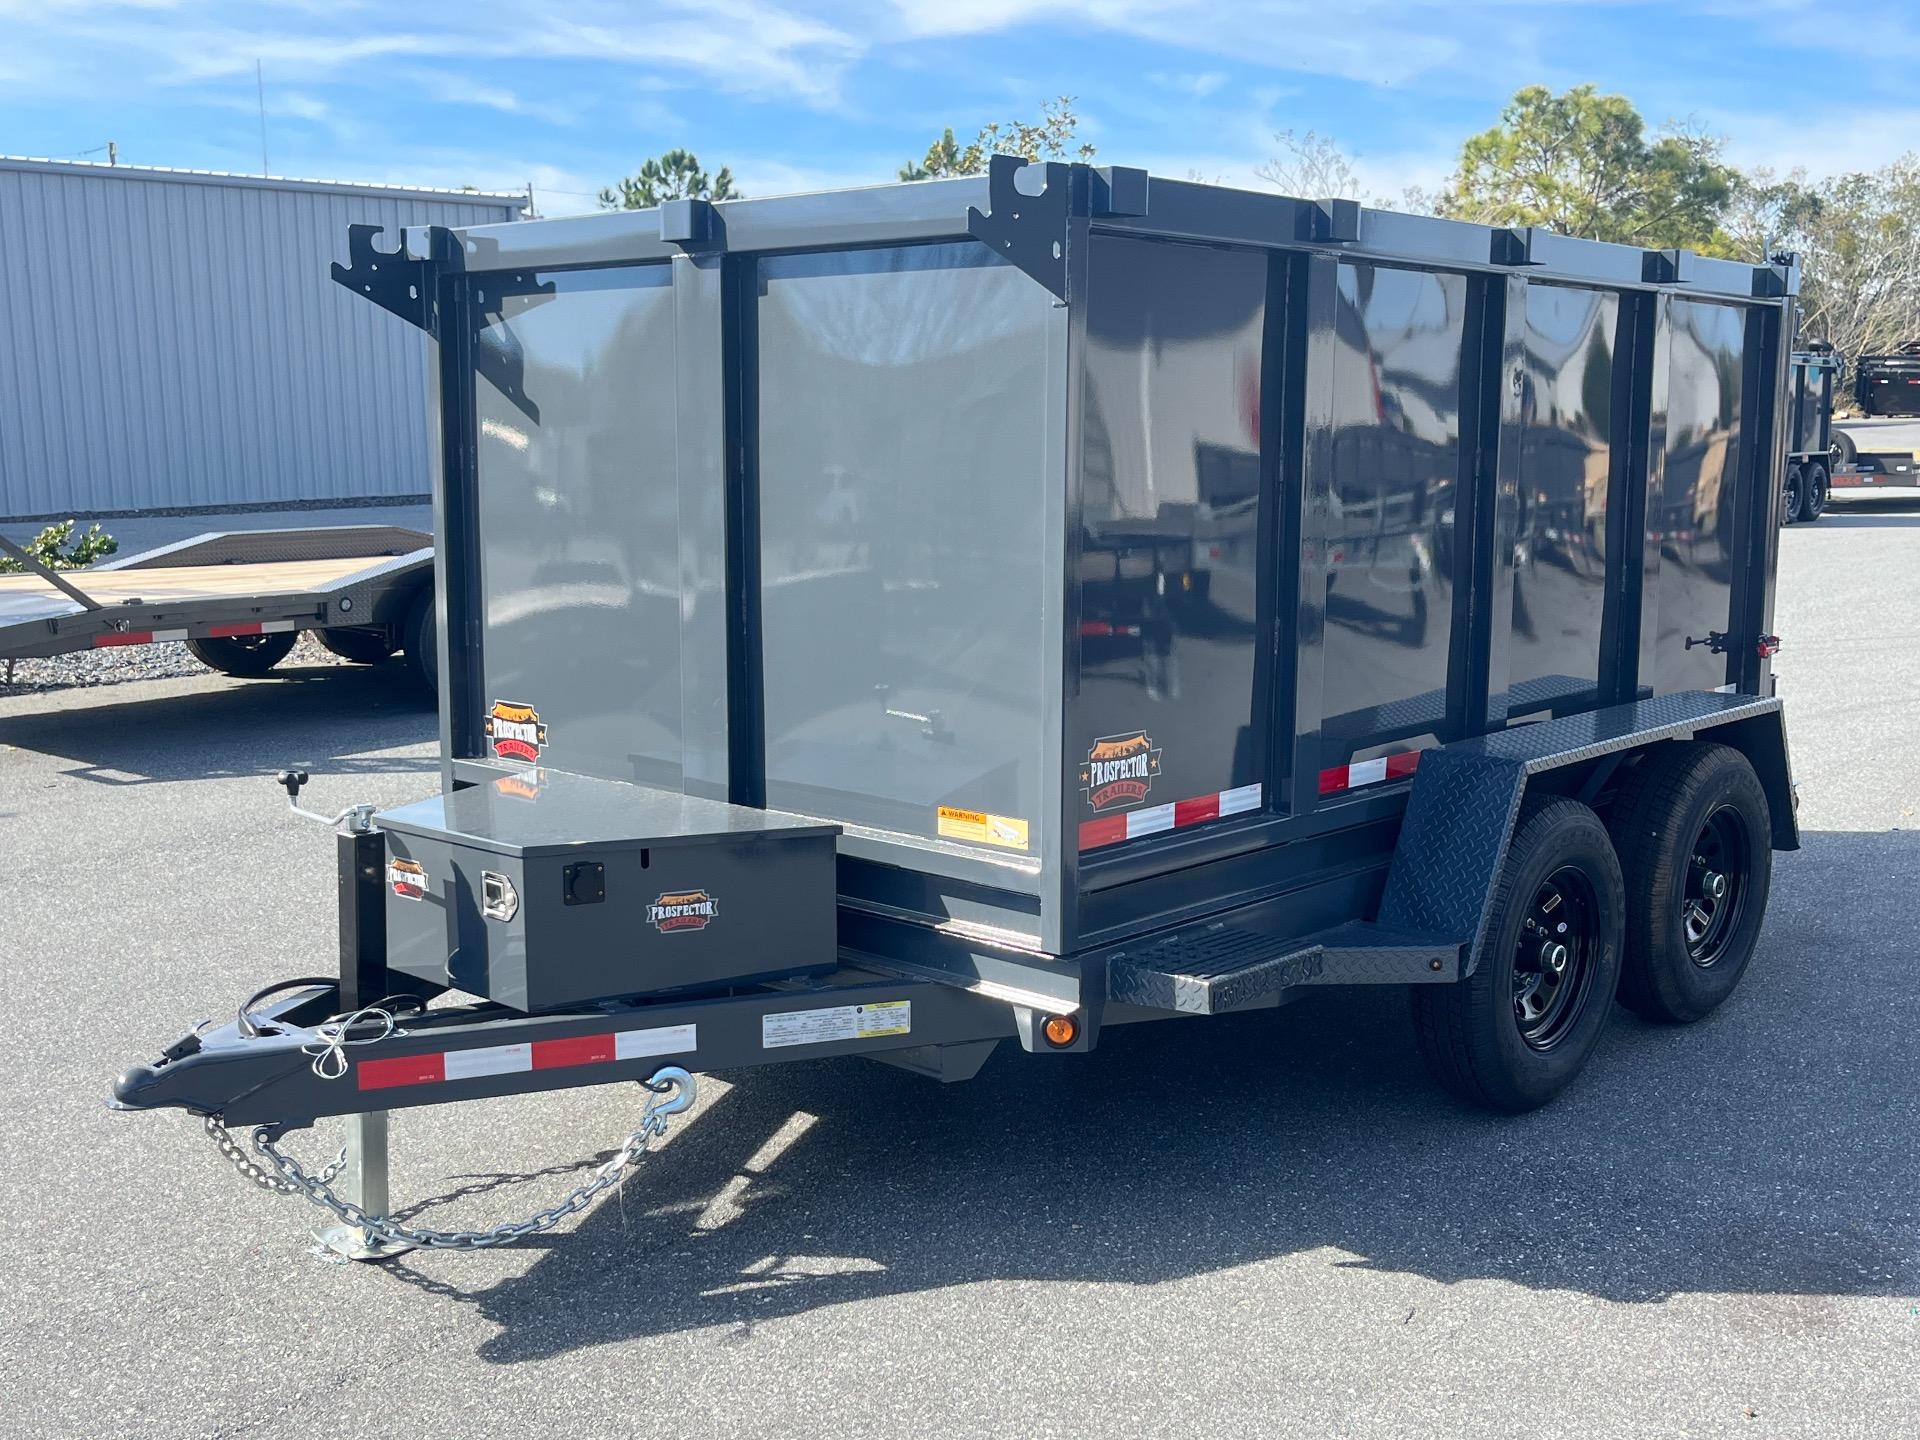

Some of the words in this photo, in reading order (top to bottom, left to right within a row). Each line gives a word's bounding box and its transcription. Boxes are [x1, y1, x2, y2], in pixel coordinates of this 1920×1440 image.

[493, 718, 538, 744] PROSPECTOR
[499, 742, 534, 757] TRAILERS
[1090, 753, 1148, 788] PROSPECTOR
[1096, 783, 1143, 803] TRAILERS
[948, 811, 980, 821] WARNING
[651, 902, 713, 920] PROSPECTOR
